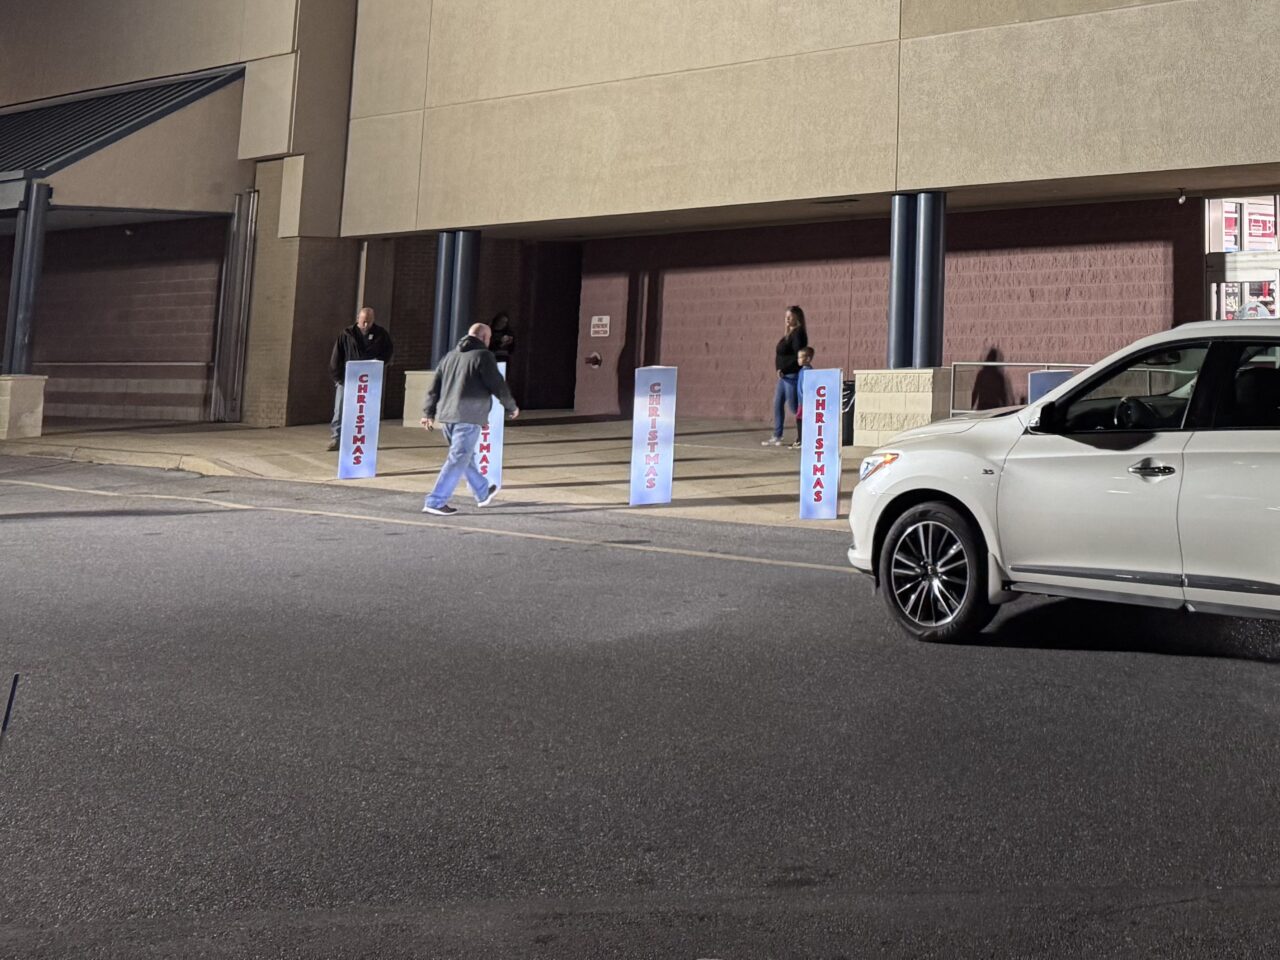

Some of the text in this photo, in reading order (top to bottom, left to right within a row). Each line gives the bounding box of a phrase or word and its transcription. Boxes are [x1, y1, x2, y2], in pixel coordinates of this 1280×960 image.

[352, 373, 369, 465] CHRISTMAS
[645, 382, 661, 489] CHRISTMAS
[812, 385, 826, 503] CHRISTMAS
